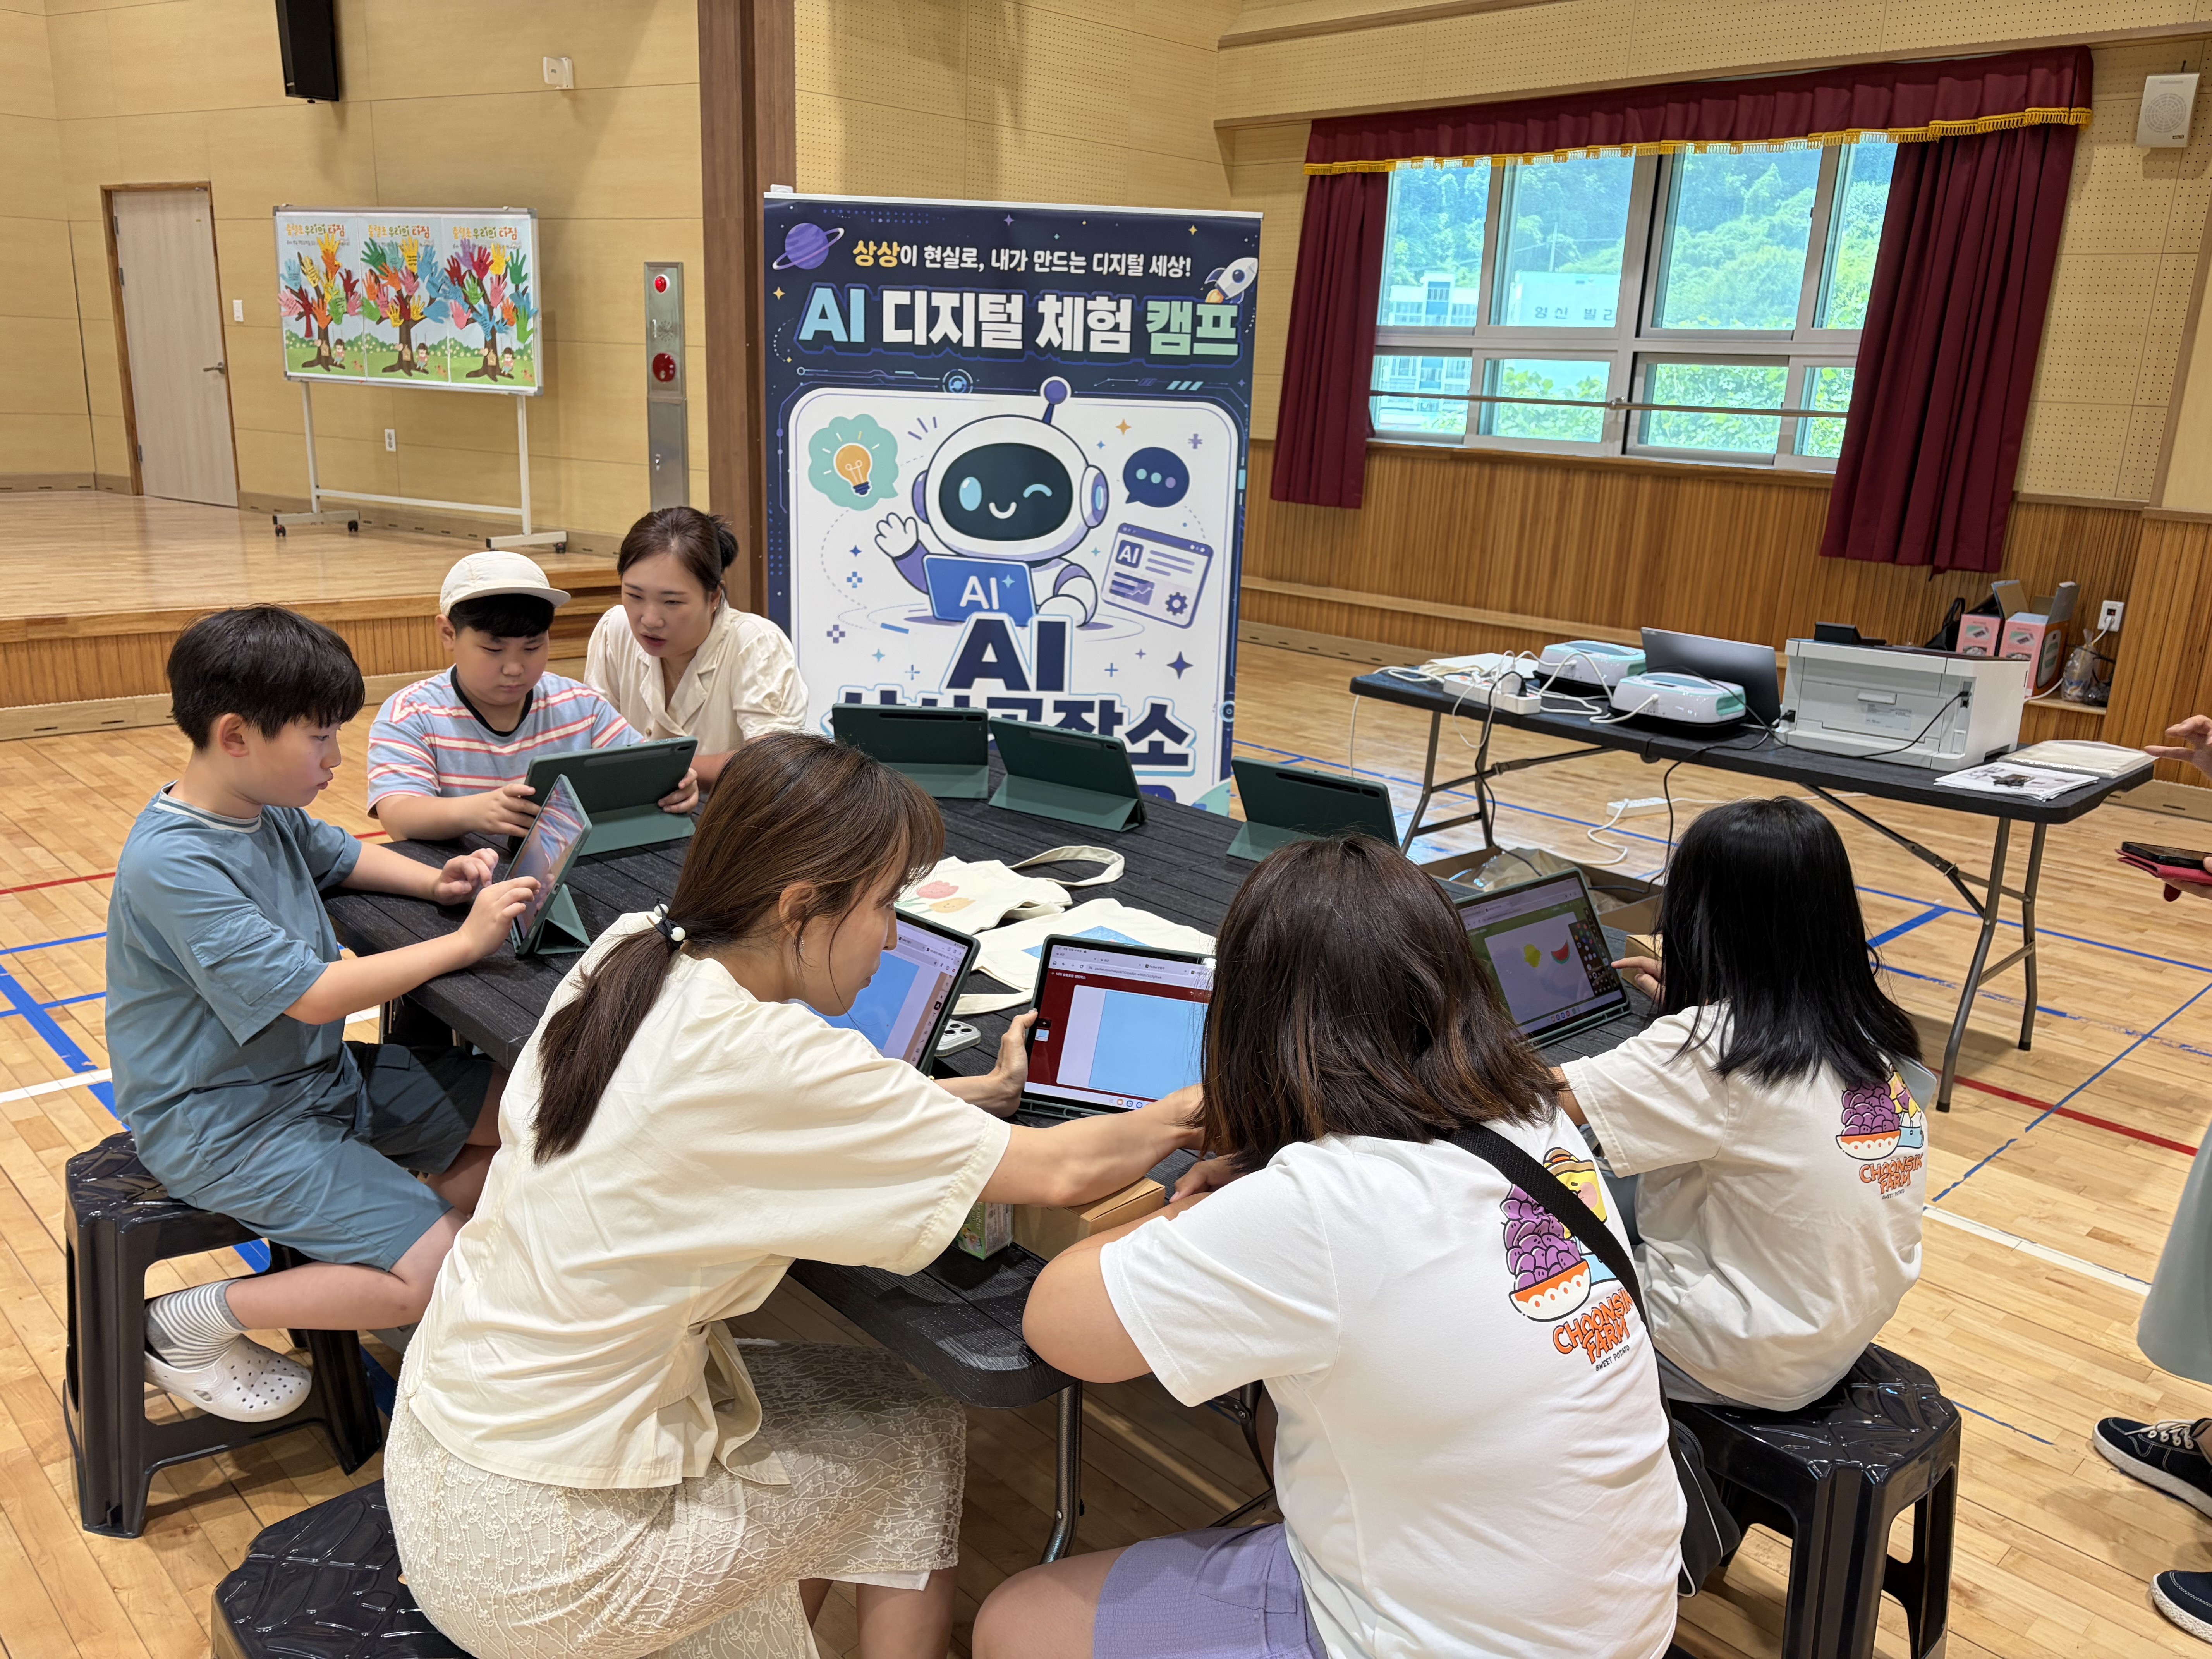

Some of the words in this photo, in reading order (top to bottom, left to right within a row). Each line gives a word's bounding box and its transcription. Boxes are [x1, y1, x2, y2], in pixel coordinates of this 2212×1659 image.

[305, 224, 326, 235] 우리의
[328, 224, 344, 237] 다짐
[389, 225, 409, 237] 우리의
[412, 225, 429, 239] 다짐
[473, 227, 496, 239] 우리의
[499, 227, 517, 240] 다짐
[853, 240, 918, 267] 상상이
[924, 245, 984, 272] 현실로,
[991, 248, 1028, 271] 내가
[1033, 250, 1087, 274] 만드는
[1092, 252, 1144, 276] 디지털
[1149, 254, 1192, 278] 세상!
[799, 288, 865, 342] AI
[883, 290, 1023, 349] 디지털
[1035, 295, 1132, 353] 체험
[1146, 301, 1238, 355] 캠프
[1117, 545, 1140, 564] AI
[959, 576, 999, 610] AI
[946, 618, 1066, 692] AI
[1859, 1152, 1923, 1183] CHOONSIK
[1878, 1170, 1911, 1194] FARM
[1582, 1316, 1630, 1365] FARM
[1595, 1356, 1613, 1371] SWEET
[1613, 1345, 1630, 1361] POTATO
